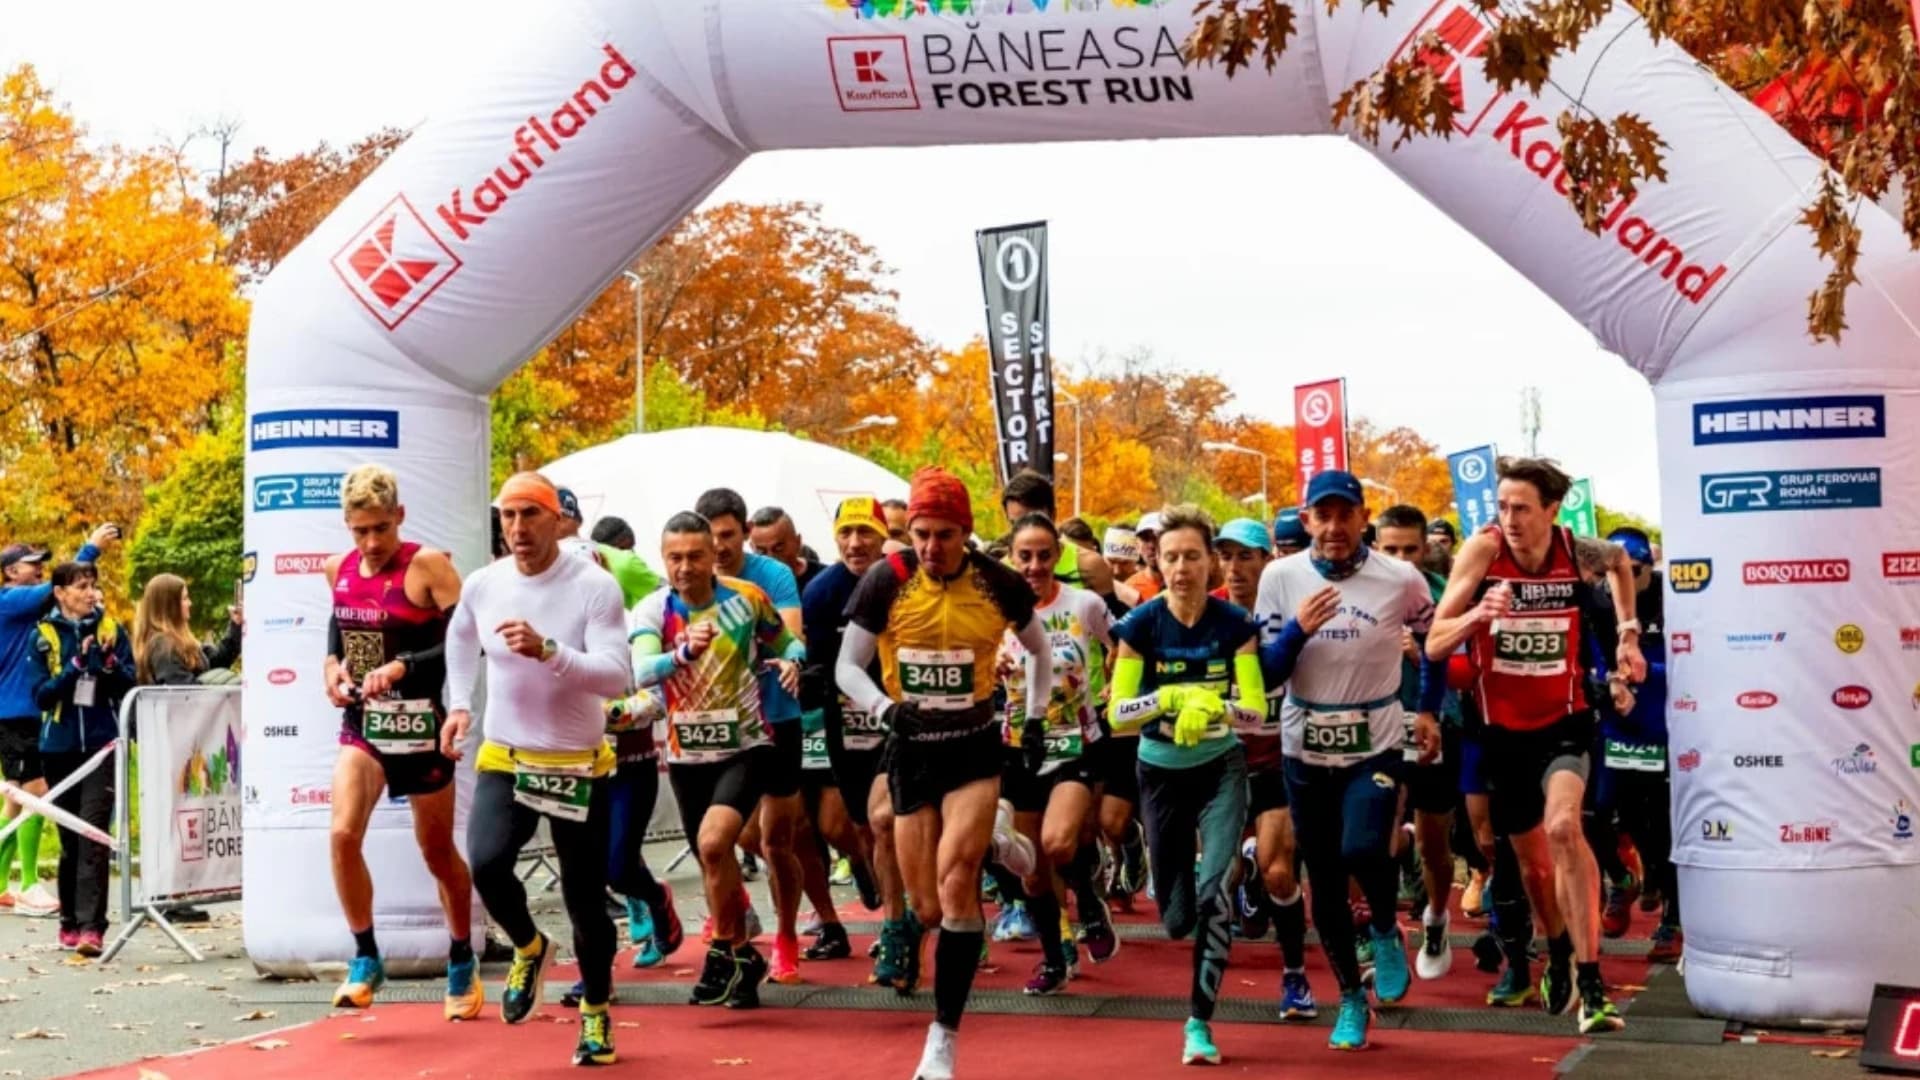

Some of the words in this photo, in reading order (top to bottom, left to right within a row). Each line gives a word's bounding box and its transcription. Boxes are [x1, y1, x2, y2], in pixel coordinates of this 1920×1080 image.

[923, 21, 1187, 74] BĂNEASA
[846, 89, 908, 100] Kaufland
[933, 79, 1091, 109] FOREST
[1106, 75, 1195, 103] RUN
[436, 43, 637, 240] Kaufland
[1493, 100, 1728, 304] Kaland
[1009, 248, 1026, 280] 1
[1000, 312, 1029, 464] SECTOR
[1030, 322, 1051, 443] START
[254, 419, 389, 441] HEINNER
[1700, 406, 1876, 434] HEINNER
[1779, 474, 1814, 485] GRUP
[1816, 472, 1877, 484] FEROVIAR
[1779, 484, 1827, 497] ROMÂN
[1669, 561, 1710, 581] RIO
[1746, 562, 1848, 582] BOROTALCO
[1318, 629, 1360, 642] ITEȘTI
[1500, 633, 1560, 653] 3033
[906, 666, 962, 687] 3418
[263, 725, 298, 737] OSHEE
[369, 714, 426, 733] 3486
[678, 723, 731, 743] 3423
[1306, 726, 1359, 746] 3051
[1733, 755, 1784, 768] OSHEE
